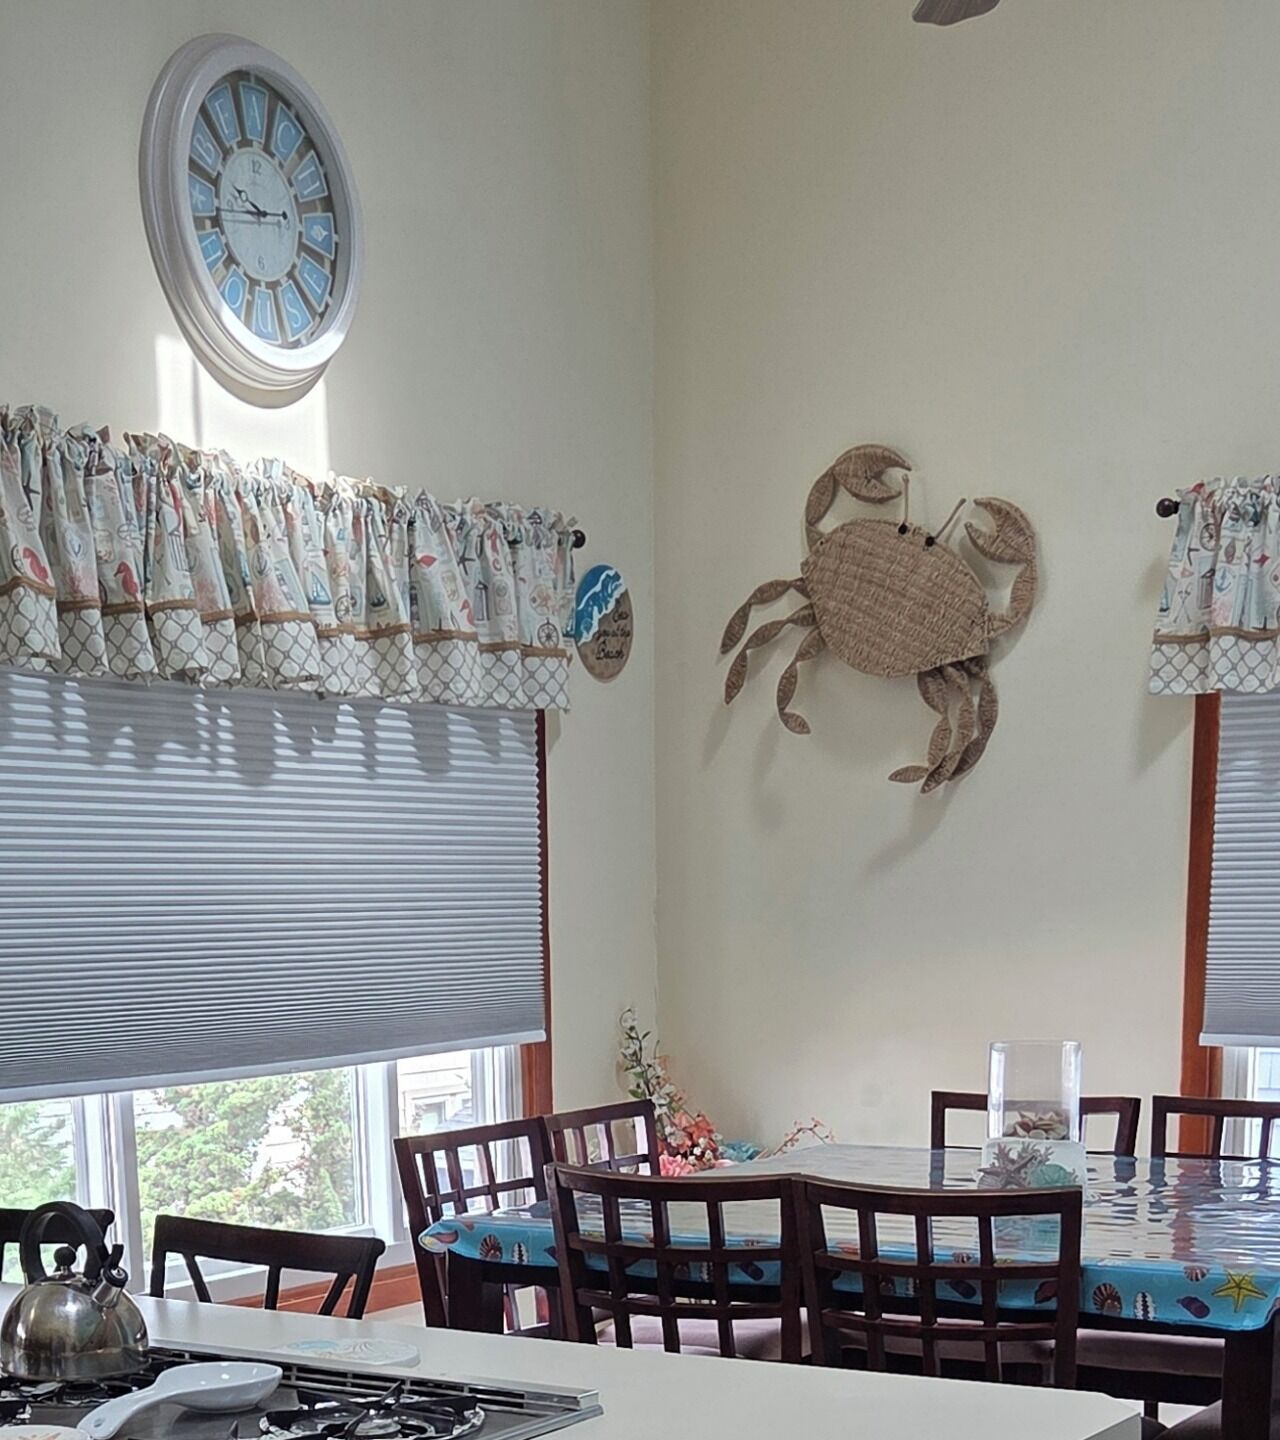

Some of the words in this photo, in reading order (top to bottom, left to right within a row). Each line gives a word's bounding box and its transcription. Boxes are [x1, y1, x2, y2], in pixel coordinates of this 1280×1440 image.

[193, 94, 321, 196] BEACH
[251, 159, 262, 175] 12
[199, 234, 326, 334] HOUSE
[257, 255, 266, 271] 6
